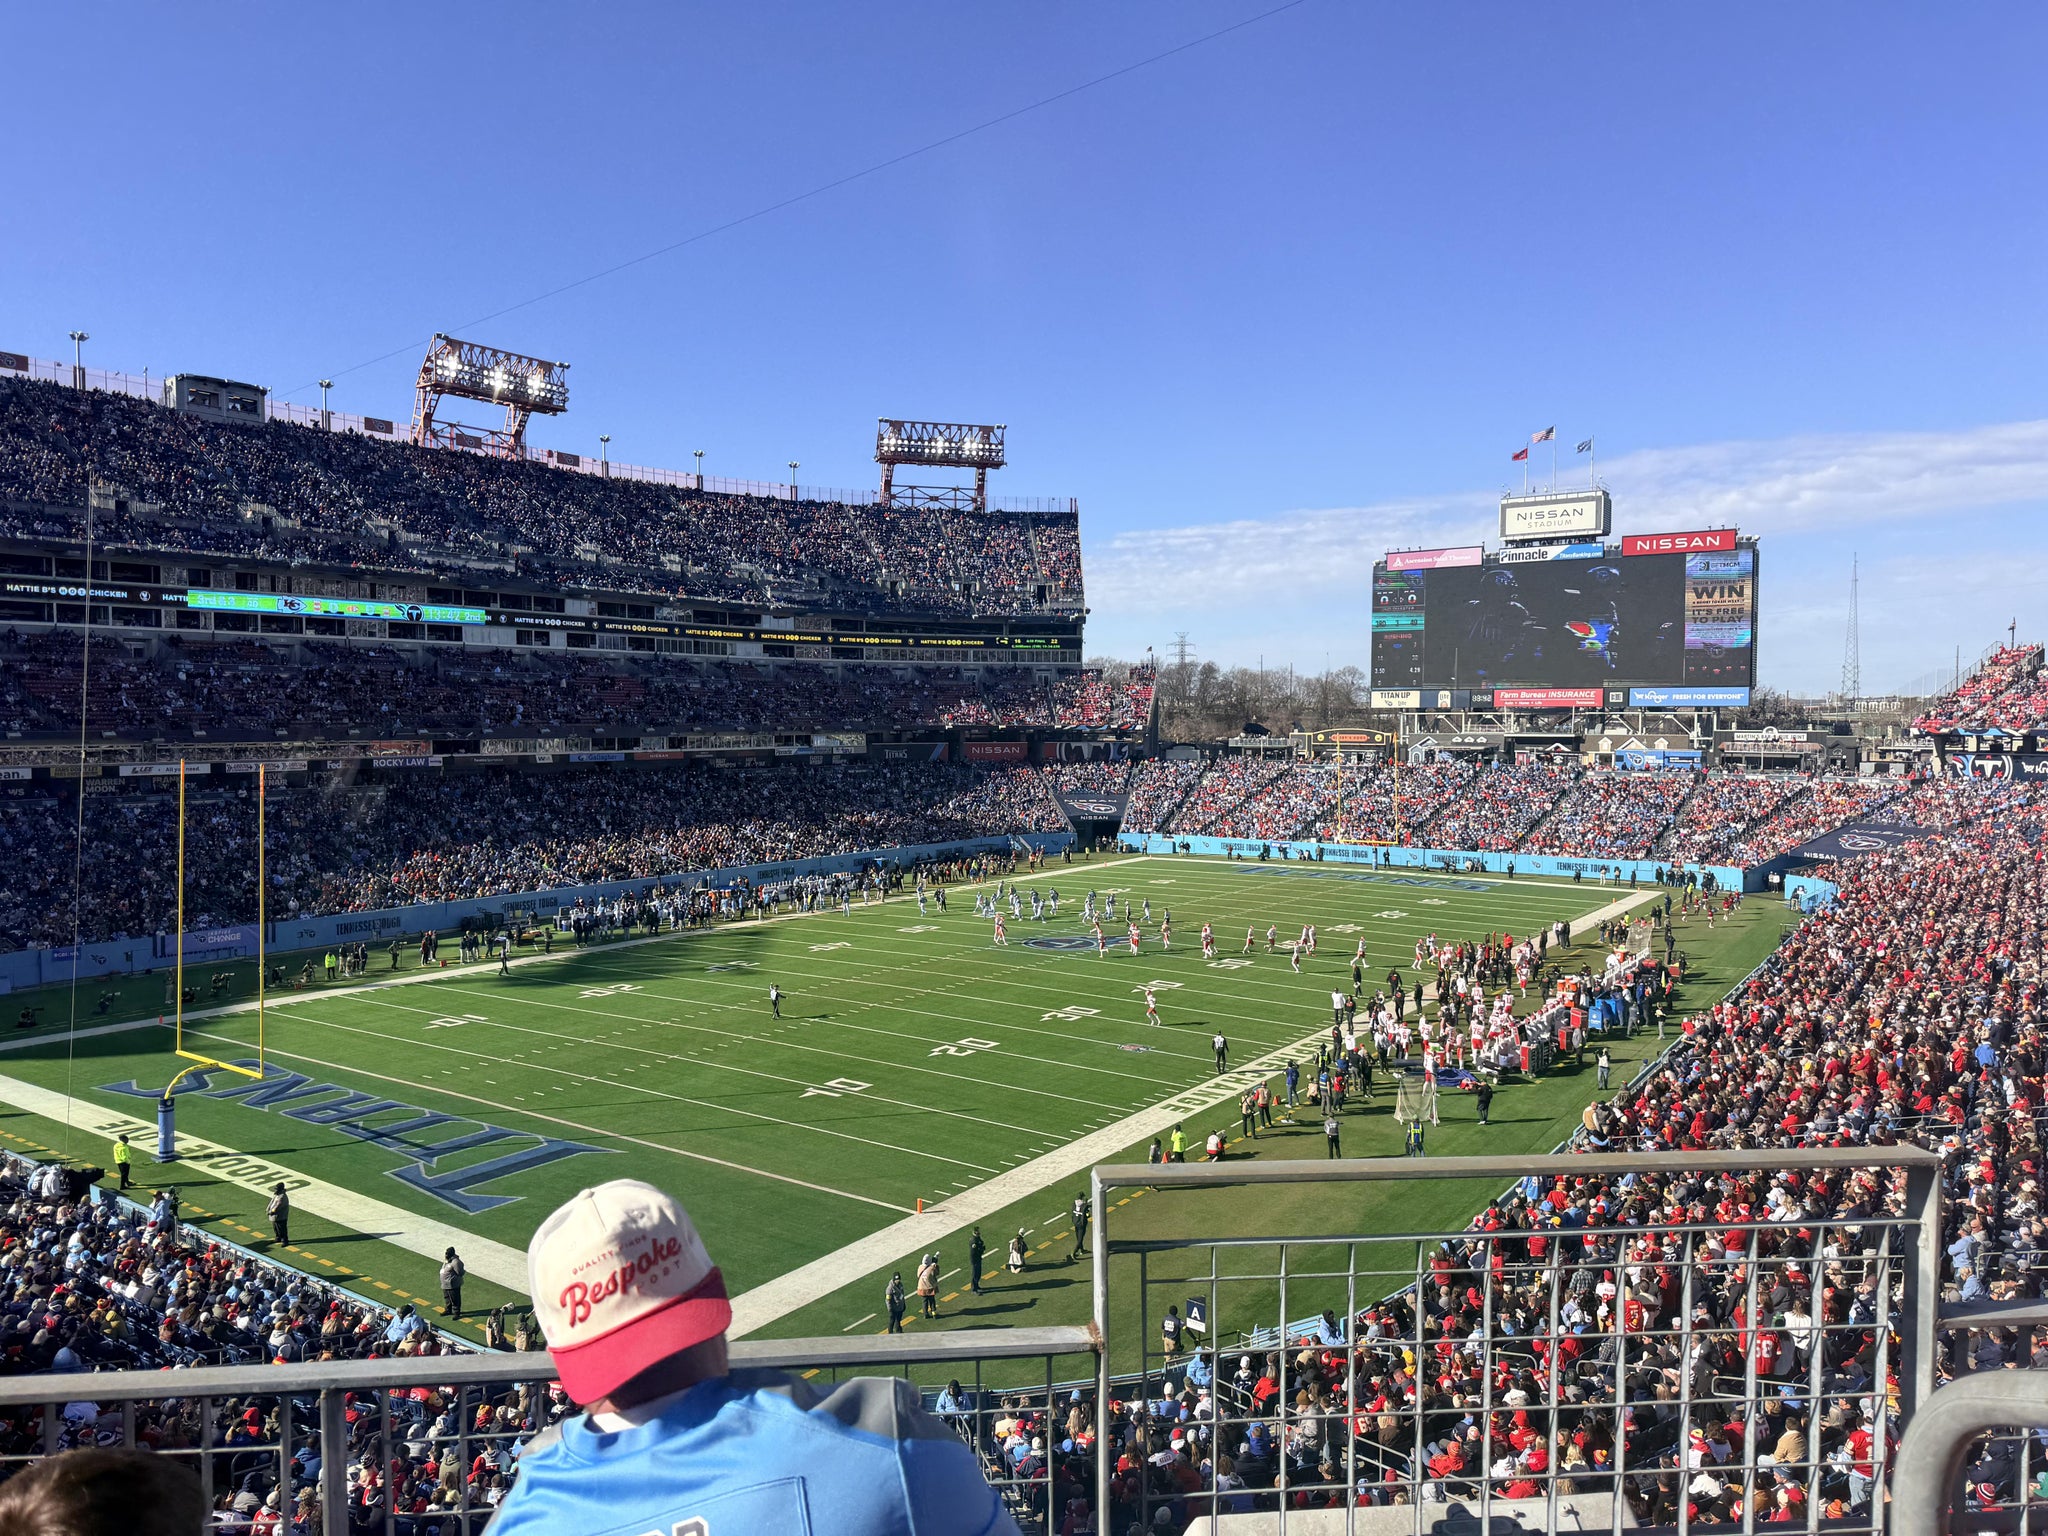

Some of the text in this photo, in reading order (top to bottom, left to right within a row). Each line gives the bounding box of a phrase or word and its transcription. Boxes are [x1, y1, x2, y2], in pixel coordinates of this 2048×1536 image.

[1516, 508, 1584, 521] NISSAN
[1528, 519, 1572, 529] STADIUM
[1636, 535, 1720, 550] NISSAN
[1500, 548, 1548, 563] Pinnacle
[6, 584, 39, 593] HATTIE
[42, 586, 56, 594] B'S
[89, 589, 128, 598] CHICKEN
[1692, 585, 1744, 599] WIN
[464, 612, 481, 622] 2nd
[1692, 608, 1712, 616] IT'S
[1692, 616, 1708, 624] TO
[1500, 691, 1520, 699] Farm
[1548, 690, 1596, 698] INSURANCE
[1644, 691, 1669, 704] Kroger
[972, 746, 1020, 754] NISSAN
[373, 758, 425, 768] ROCKY LAW
[1221, 842, 1244, 850] TENNESSEE
[1352, 850, 1368, 858] TOUGH
[1804, 852, 1837, 860] NISSAN
[1557, 862, 1588, 872] TENNESSEE
[503, 897, 558, 912] TENNESSEE TOUGH
[336, 920, 374, 936] TENNESSEE
[208, 933, 241, 944] CHANGE
[1206, 958, 1255, 970] 50
[1046, 1006, 1102, 1021] 30
[430, 1014, 488, 1027] 10
[934, 1038, 1001, 1056] 20
[806, 1078, 873, 1097] 10
[93, 1058, 625, 1215] TITANS
[182, 1144, 312, 1192] CHOOSE
[572, 1250, 615, 1275] QUALITY
[560, 1236, 682, 1328] Bespoke
[1191, 1307, 1200, 1320] A
